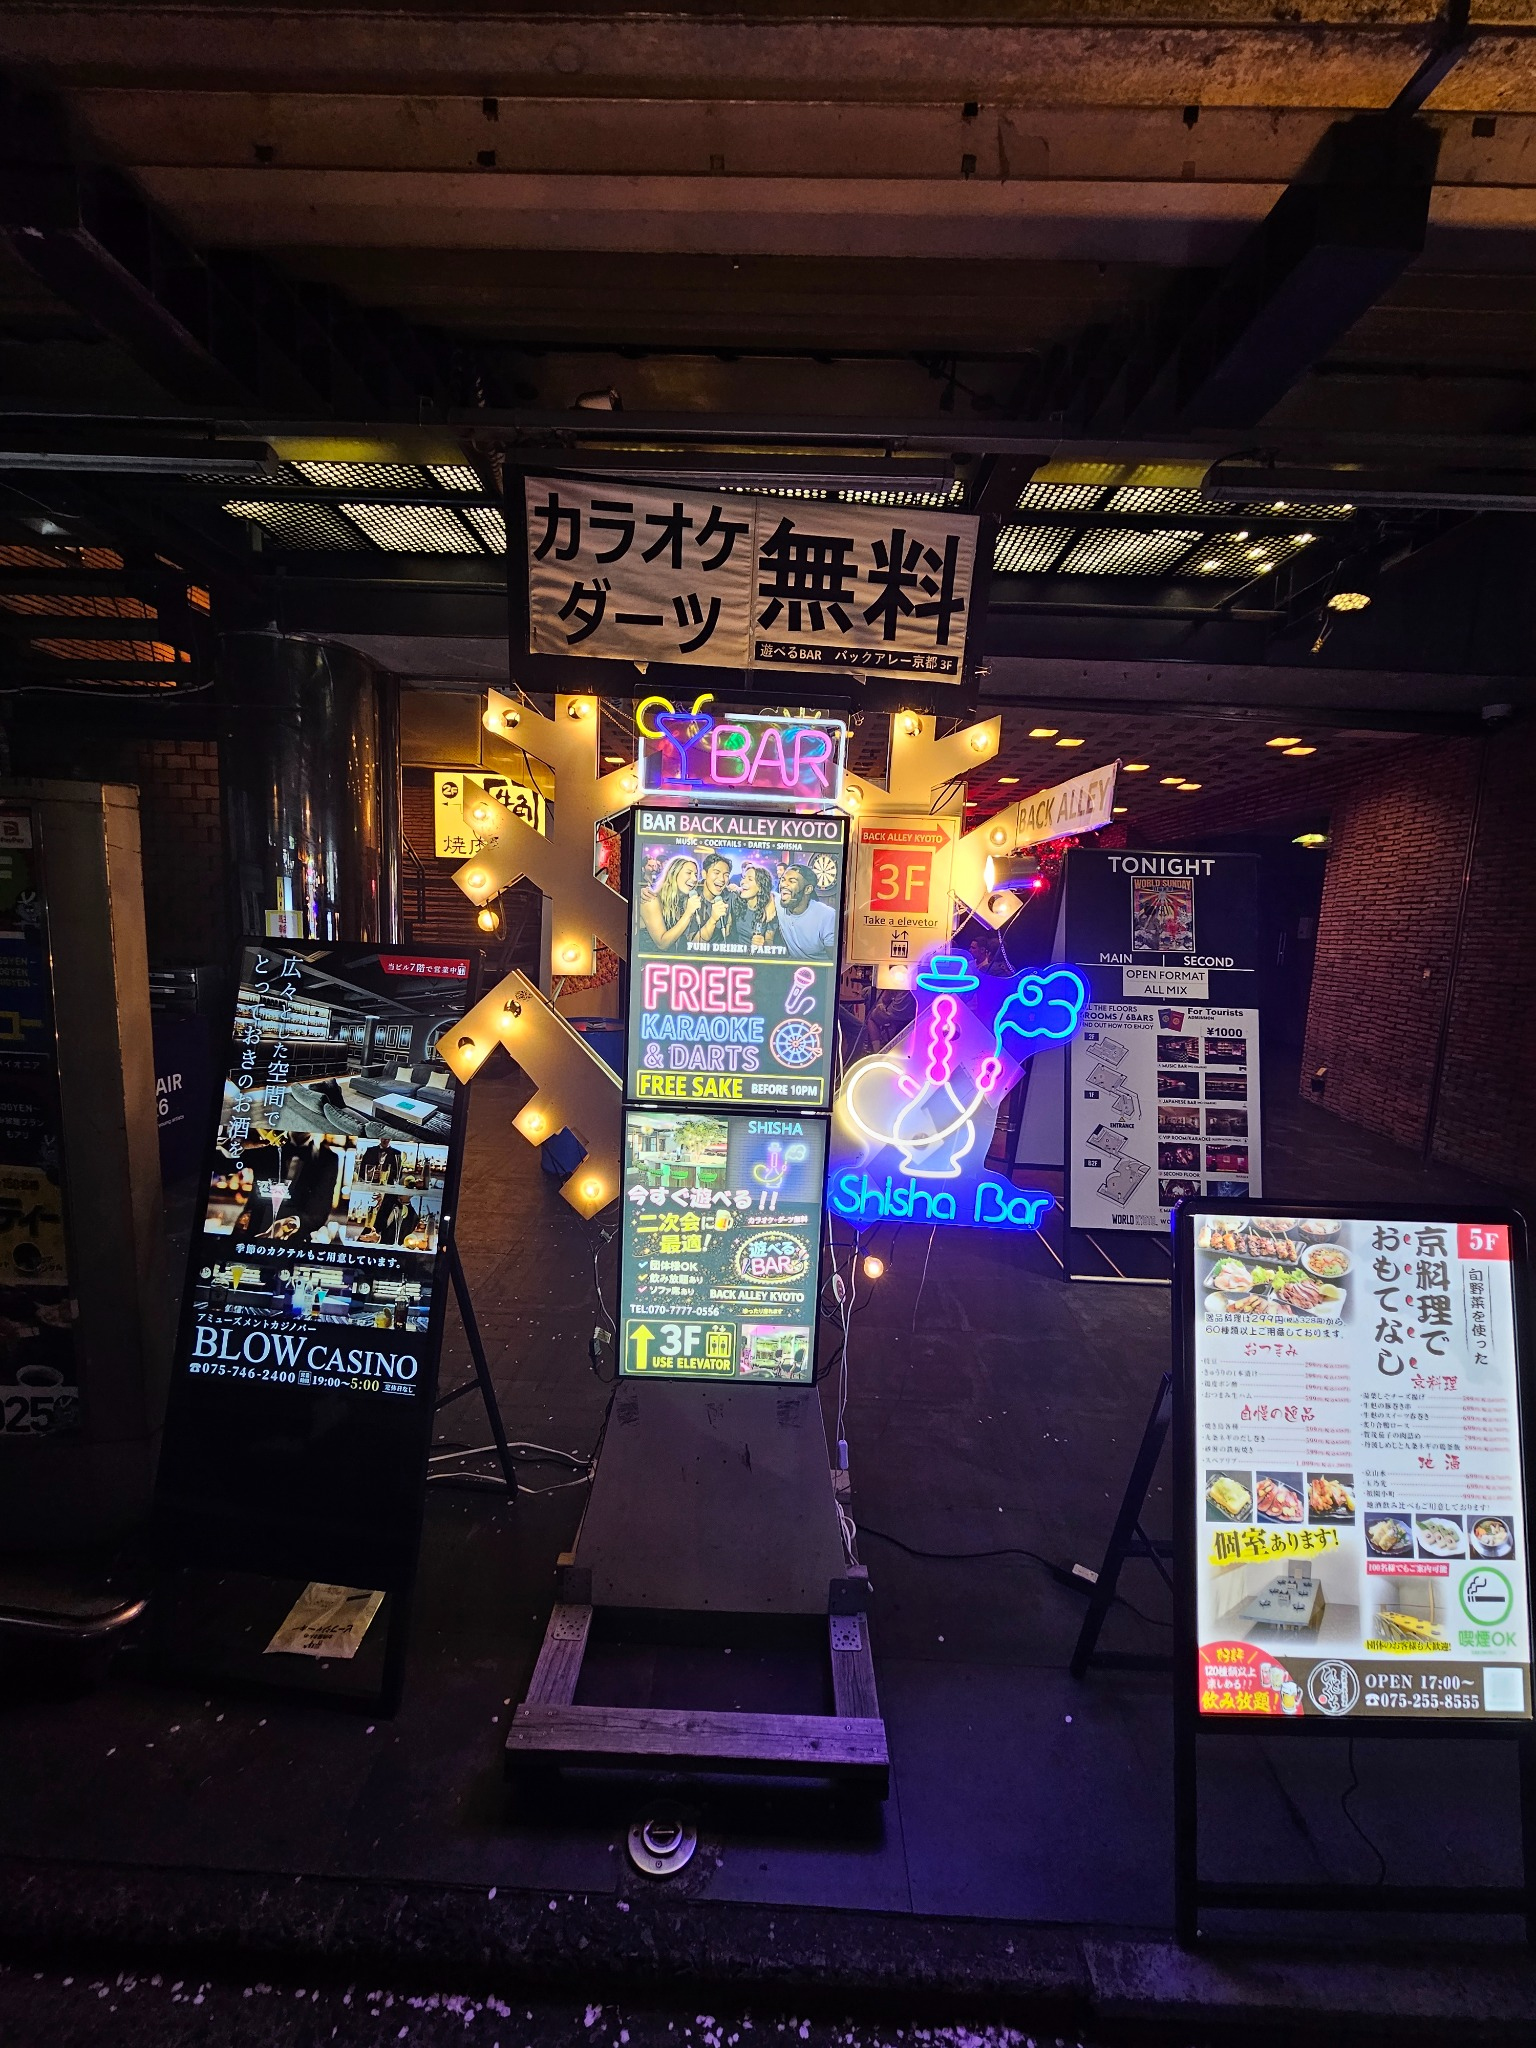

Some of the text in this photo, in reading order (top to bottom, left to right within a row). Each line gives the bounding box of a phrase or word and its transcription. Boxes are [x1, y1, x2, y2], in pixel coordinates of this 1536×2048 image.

[533, 493, 750, 572] カラオケ
[757, 517, 966, 646] 無料
[557, 577, 722, 654] ダーツ
[760, 643, 954, 671] 遊べるBAR バックアレー京都 3F
[711, 724, 832, 788] BAR
[442, 783, 459, 796] 2F
[1017, 776, 1112, 834] BACK ALLEY
[642, 813, 838, 839] BAR BACK ALLEY KYOTO
[675, 837, 803, 851] MUSIC COCKTAILS DARTS SHISHA
[863, 831, 943, 844] BACK ALLEY KYOTO
[1107, 856, 1216, 876] TONIGHT
[876, 863, 927, 901] 3F
[1134, 878, 1161, 889] WORLD
[1162, 879, 1191, 891] SUNDAY
[863, 915, 938, 928] Take a elevetor
[713, 943, 747, 954] DRINK!
[750, 944, 787, 956] PARTY!
[387, 962, 458, 976] 当ビル7階で営業中
[1099, 953, 1234, 967] MAIN SECOND
[1126, 969, 1206, 981] OPEN FORMAT
[643, 963, 755, 1014] FREE
[1144, 985, 1188, 995] ALL MIX
[1109, 1005, 1138, 1013] FLOORS
[1126, 1014, 1154, 1022] 6BARS
[1187, 1007, 1244, 1017] For Tourists
[640, 1013, 766, 1044] KARAOKE
[1206, 1027, 1243, 1038] ¥1000
[263, 955, 305, 1127] 広々とした空間で
[228, 954, 271, 1171] とっておきのお酒を。
[643, 1042, 760, 1073] & DARTS
[640, 1074, 818, 1099] FREE SAKE BEFORE 10PM
[748, 1120, 804, 1136] SHISHA
[628, 1184, 779, 1211] 今すぐ遊べる!!
[833, 1174, 1049, 1225] Shisha Bar
[637, 1211, 715, 1233] 二次会に
[1112, 1214, 1135, 1225] WORLD
[659, 1233, 712, 1255] 最適!
[1469, 1227, 1499, 1251] 5F
[235, 1242, 402, 1270] 季節のカクテルもご用意しています。
[749, 1240, 796, 1259] 遊べる
[649, 1259, 699, 1273] 団体様OK
[750, 1256, 793, 1276] BAR
[649, 1273, 704, 1286] 飲み放題あり
[709, 1288, 805, 1303] BACK ALLEY KYOTO
[1414, 1225, 1453, 1356] 京料理で
[1371, 1225, 1405, 1377] おもてなし
[197, 1313, 317, 1333] アミューズメントカジノバー
[1468, 1267, 1489, 1366] 旬野菜を使った
[659, 1323, 702, 1357] 3F
[1244, 1342, 1299, 1358] おつまみ
[192, 1326, 418, 1381] BLOW CASINO
[652, 1356, 731, 1371] USE ELEVATOR
[202, 1362, 296, 1385] 075-746-2400
[384, 1383, 414, 1395] 定休日なし
[1410, 1373, 1458, 1392] 京料理
[1240, 1404, 1316, 1423] 自慢の逸品
[1213, 1527, 1340, 1560] 個室あります!
[1368, 1562, 1448, 1575] 100名様でもご案内可能
[1366, 1640, 1452, 1652] 団体のお客様も大歓迎!
[1458, 1629, 1518, 1648] 喫煙OK
[1204, 1666, 1258, 1678] 120種類以上
[1364, 1673, 1413, 1689] OPEN
[1201, 1690, 1280, 1713] 飲み放題!
[1381, 1693, 1480, 1710] 075-255-8555
